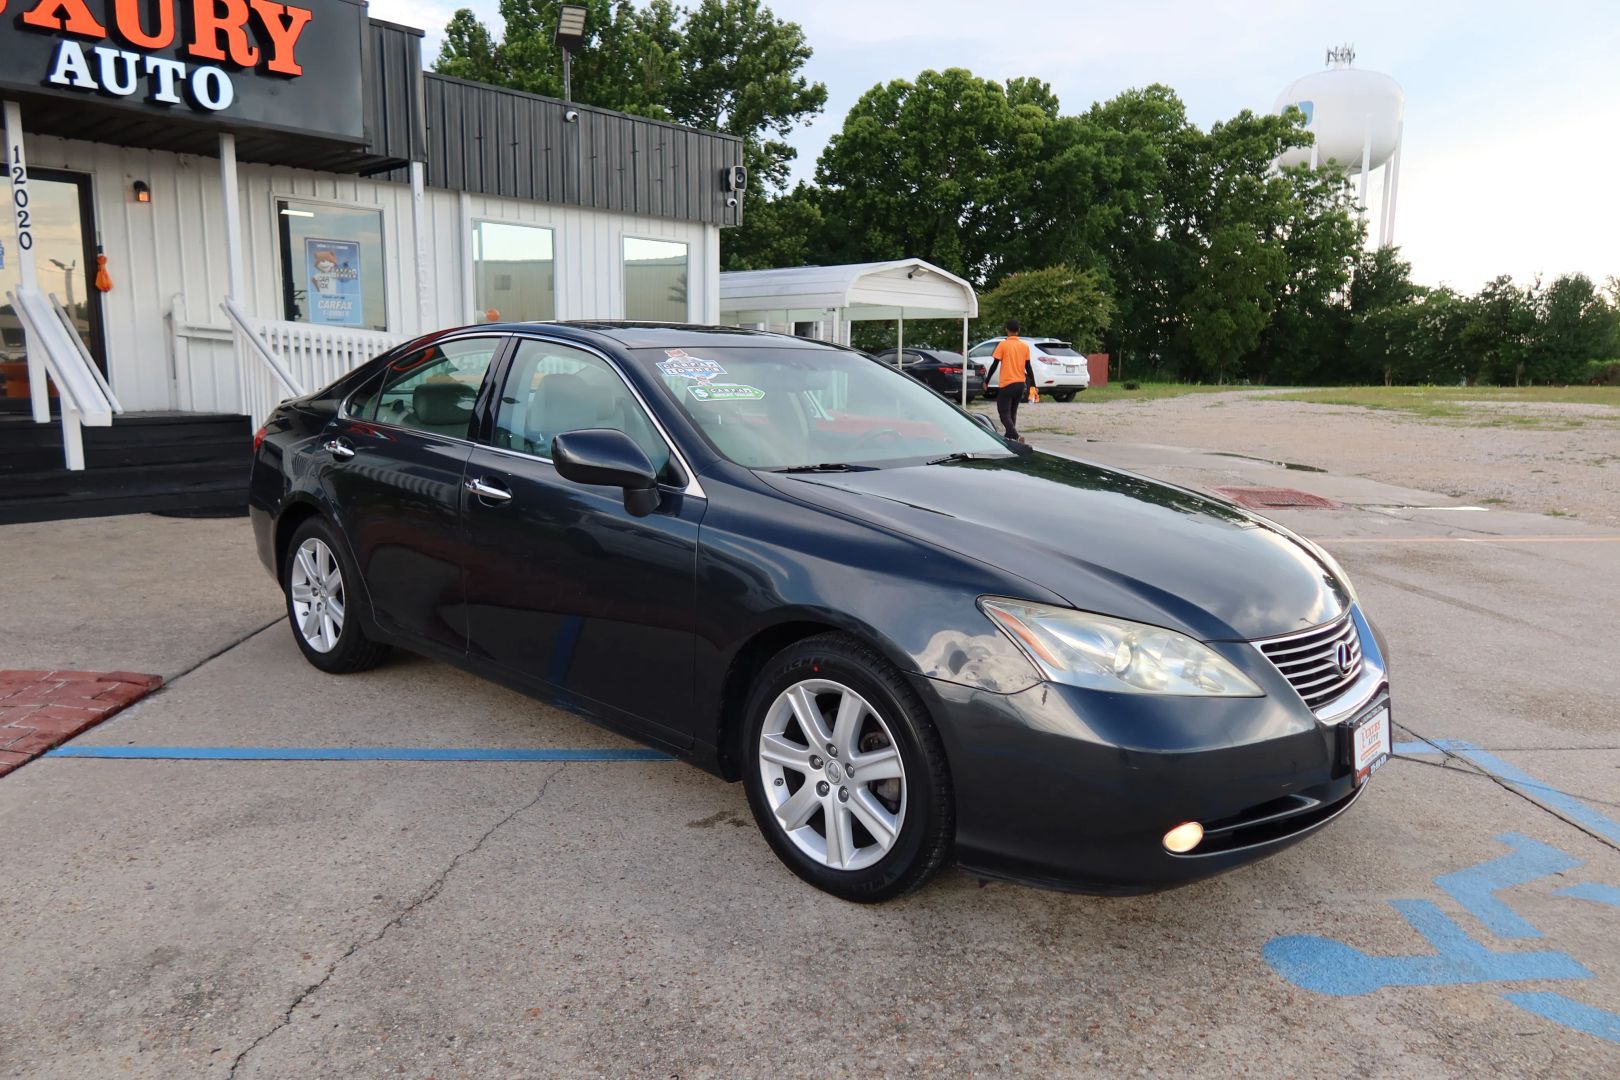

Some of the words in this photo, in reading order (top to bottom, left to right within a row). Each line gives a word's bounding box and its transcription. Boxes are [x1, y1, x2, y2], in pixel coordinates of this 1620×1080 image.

[0, 0, 312, 76] URY
[50, 40, 234, 111] AUTO
[12, 144, 33, 250] 12020
